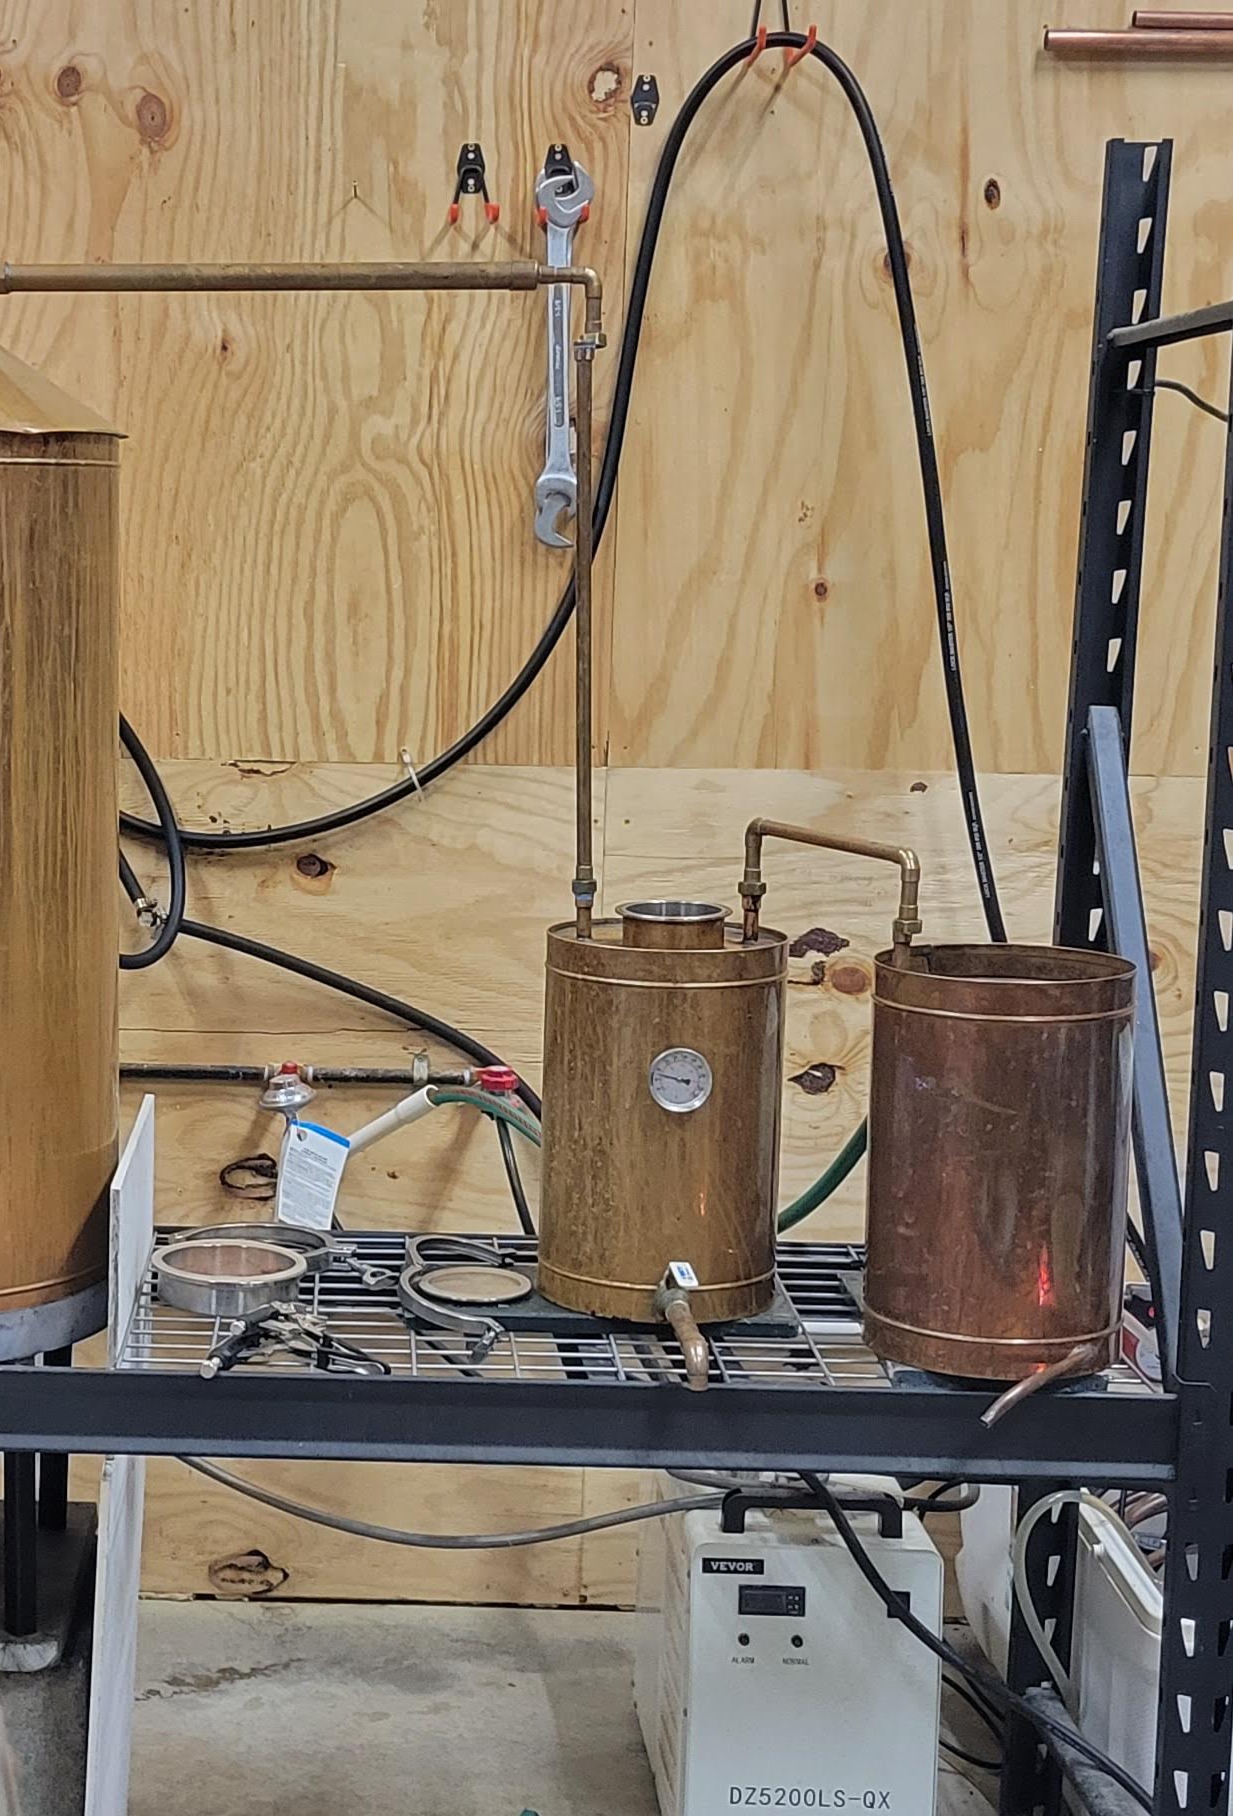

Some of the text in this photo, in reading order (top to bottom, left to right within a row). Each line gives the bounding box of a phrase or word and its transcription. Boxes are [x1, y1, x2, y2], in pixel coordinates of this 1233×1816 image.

[710, 1561, 754, 1572] VEVOR
[731, 1656, 755, 1664] ALARM
[782, 1657, 809, 1665] NORMAL
[729, 1786, 891, 1810] DZ5200LS-QX
